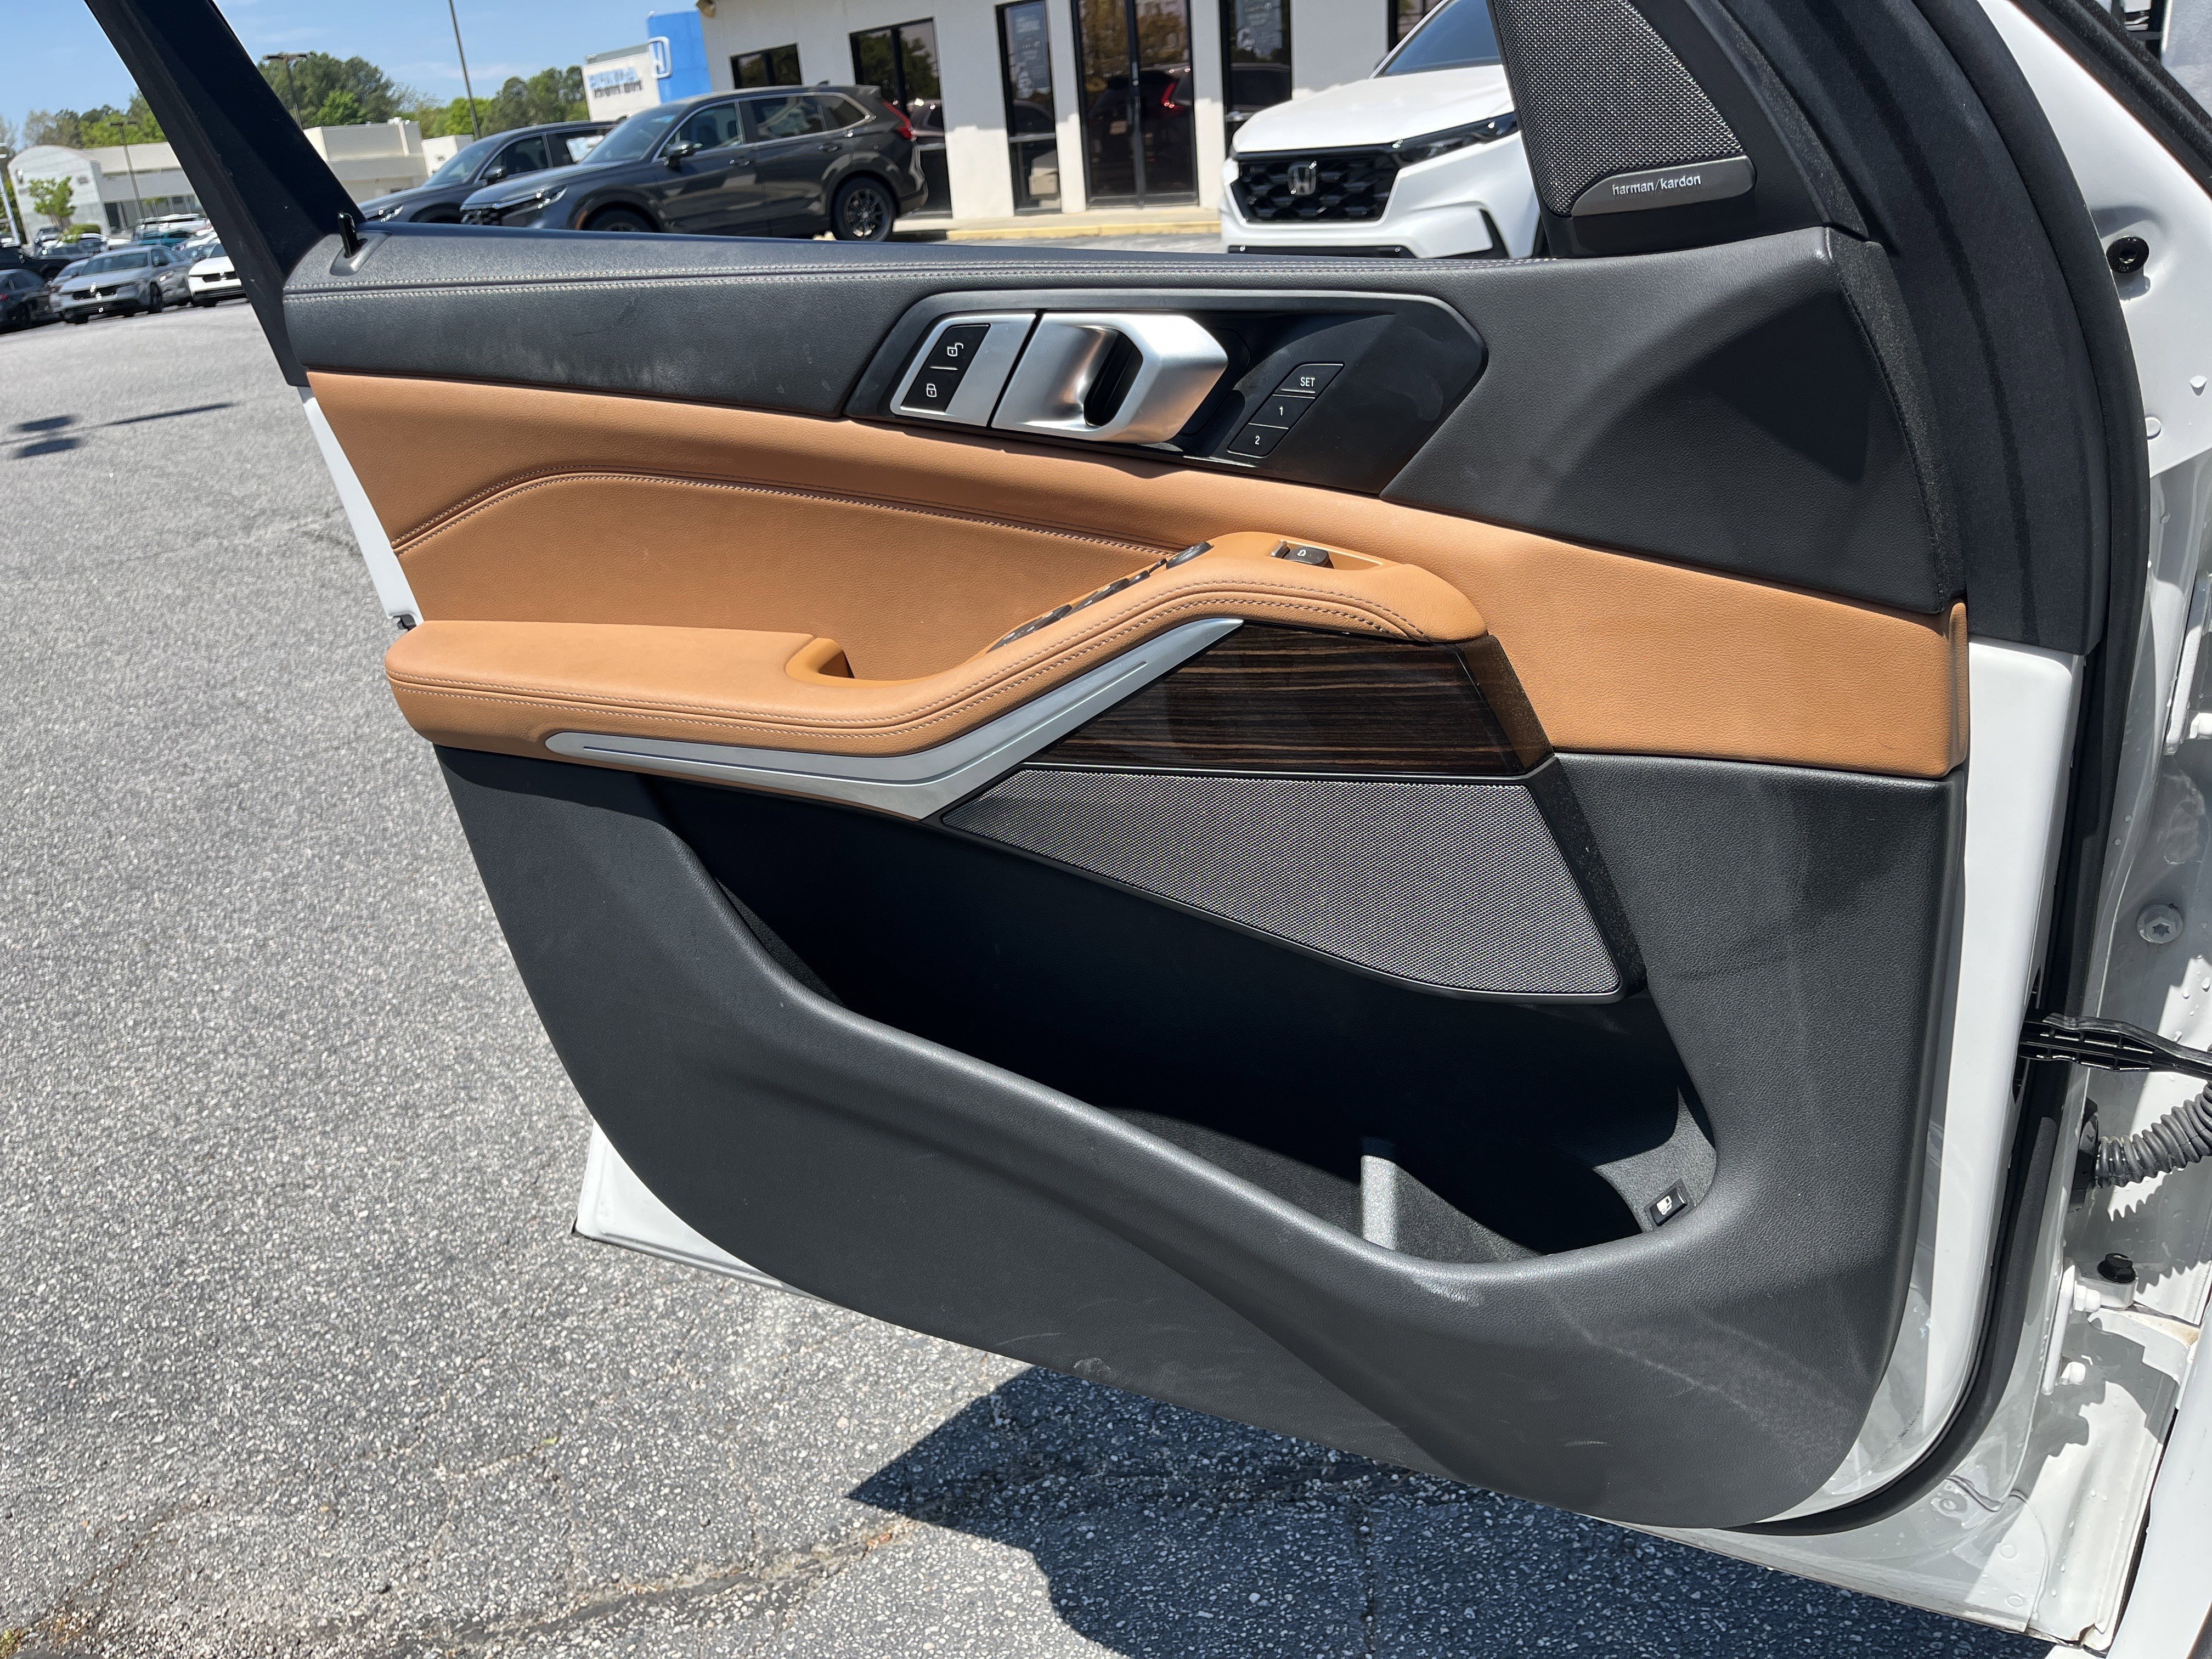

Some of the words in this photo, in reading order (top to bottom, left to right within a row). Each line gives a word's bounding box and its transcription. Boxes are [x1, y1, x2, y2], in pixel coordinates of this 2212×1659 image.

[1612, 174, 1701, 195] harman/kardon
[1300, 376, 1316, 387] SET
[1279, 406, 1284, 416] 1
[1254, 436, 1261, 445] 2
